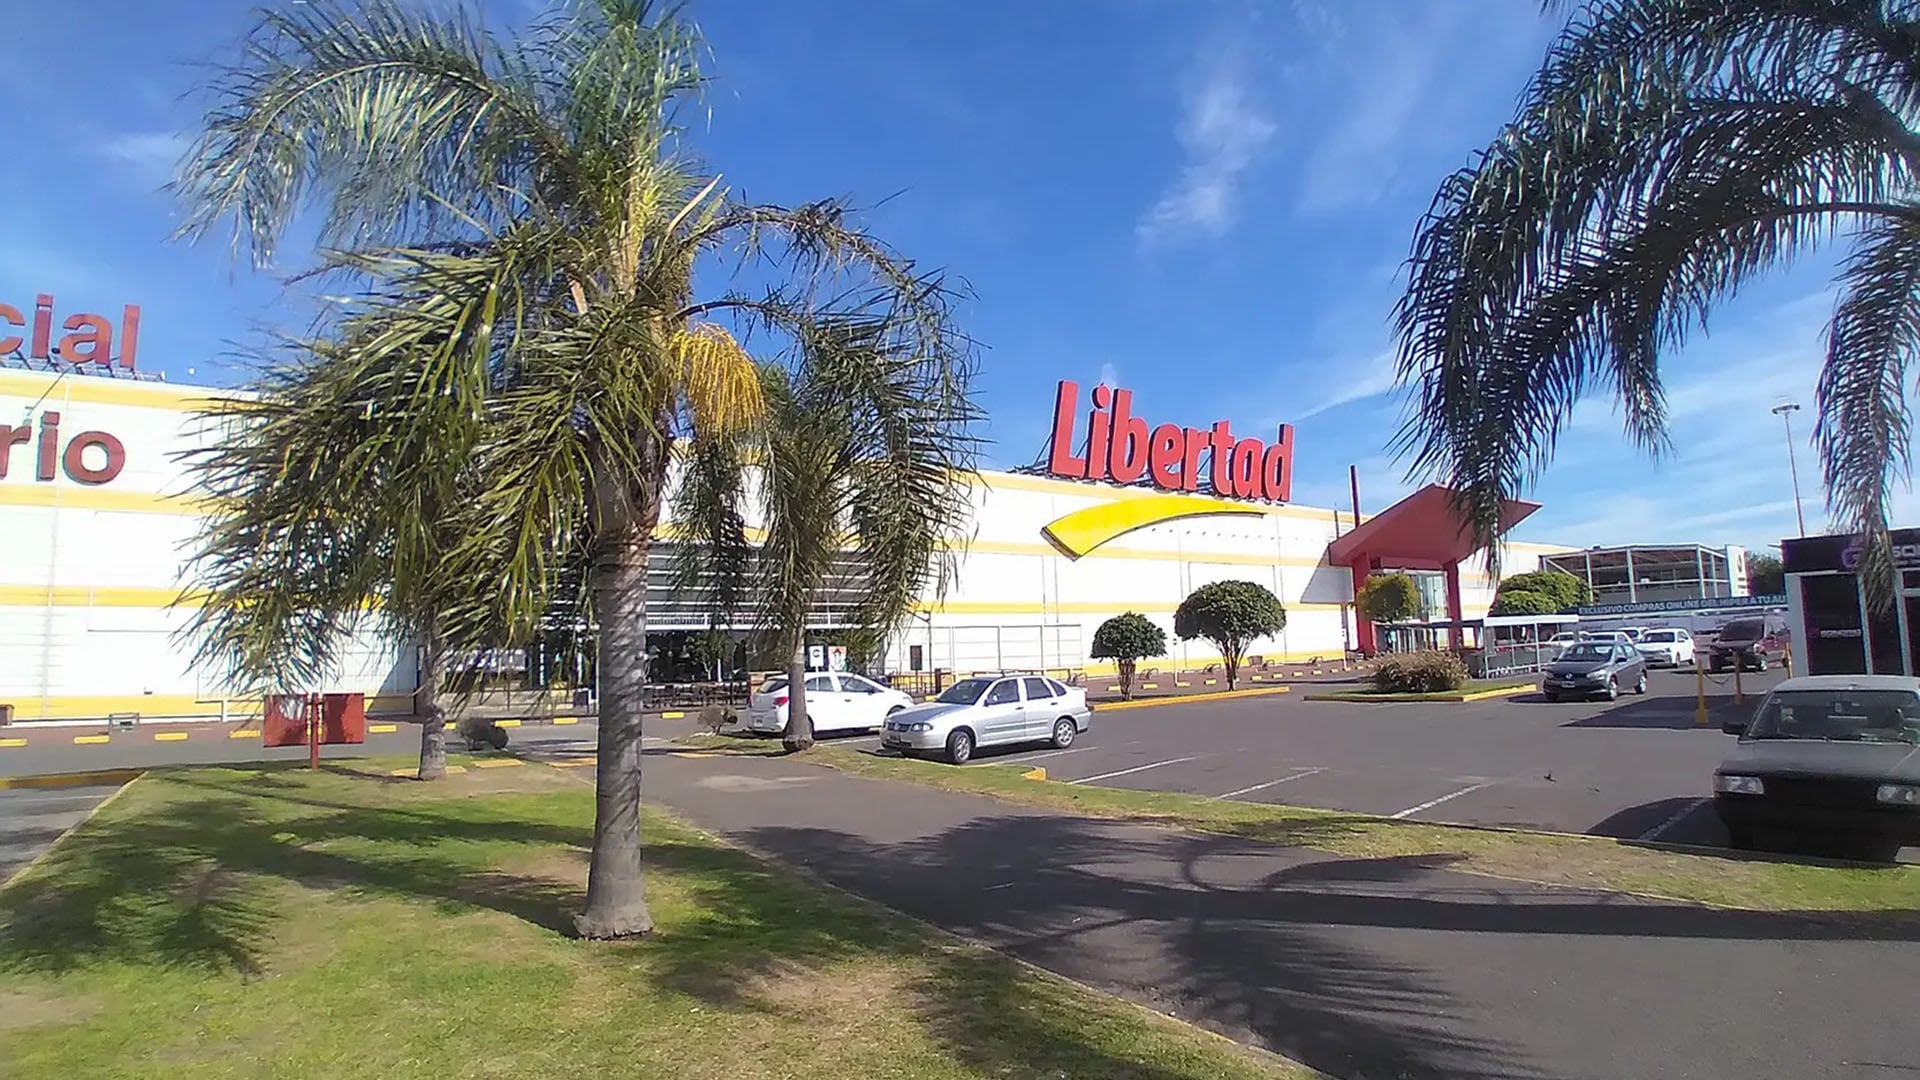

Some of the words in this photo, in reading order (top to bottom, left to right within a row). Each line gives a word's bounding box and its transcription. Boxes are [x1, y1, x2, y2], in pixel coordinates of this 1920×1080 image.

[0, 411, 126, 485] rio
[1049, 380, 1294, 502] Libertad
[1623, 602, 1665, 612] COMPRAS
[1666, 600, 1700, 609] ONLINE
